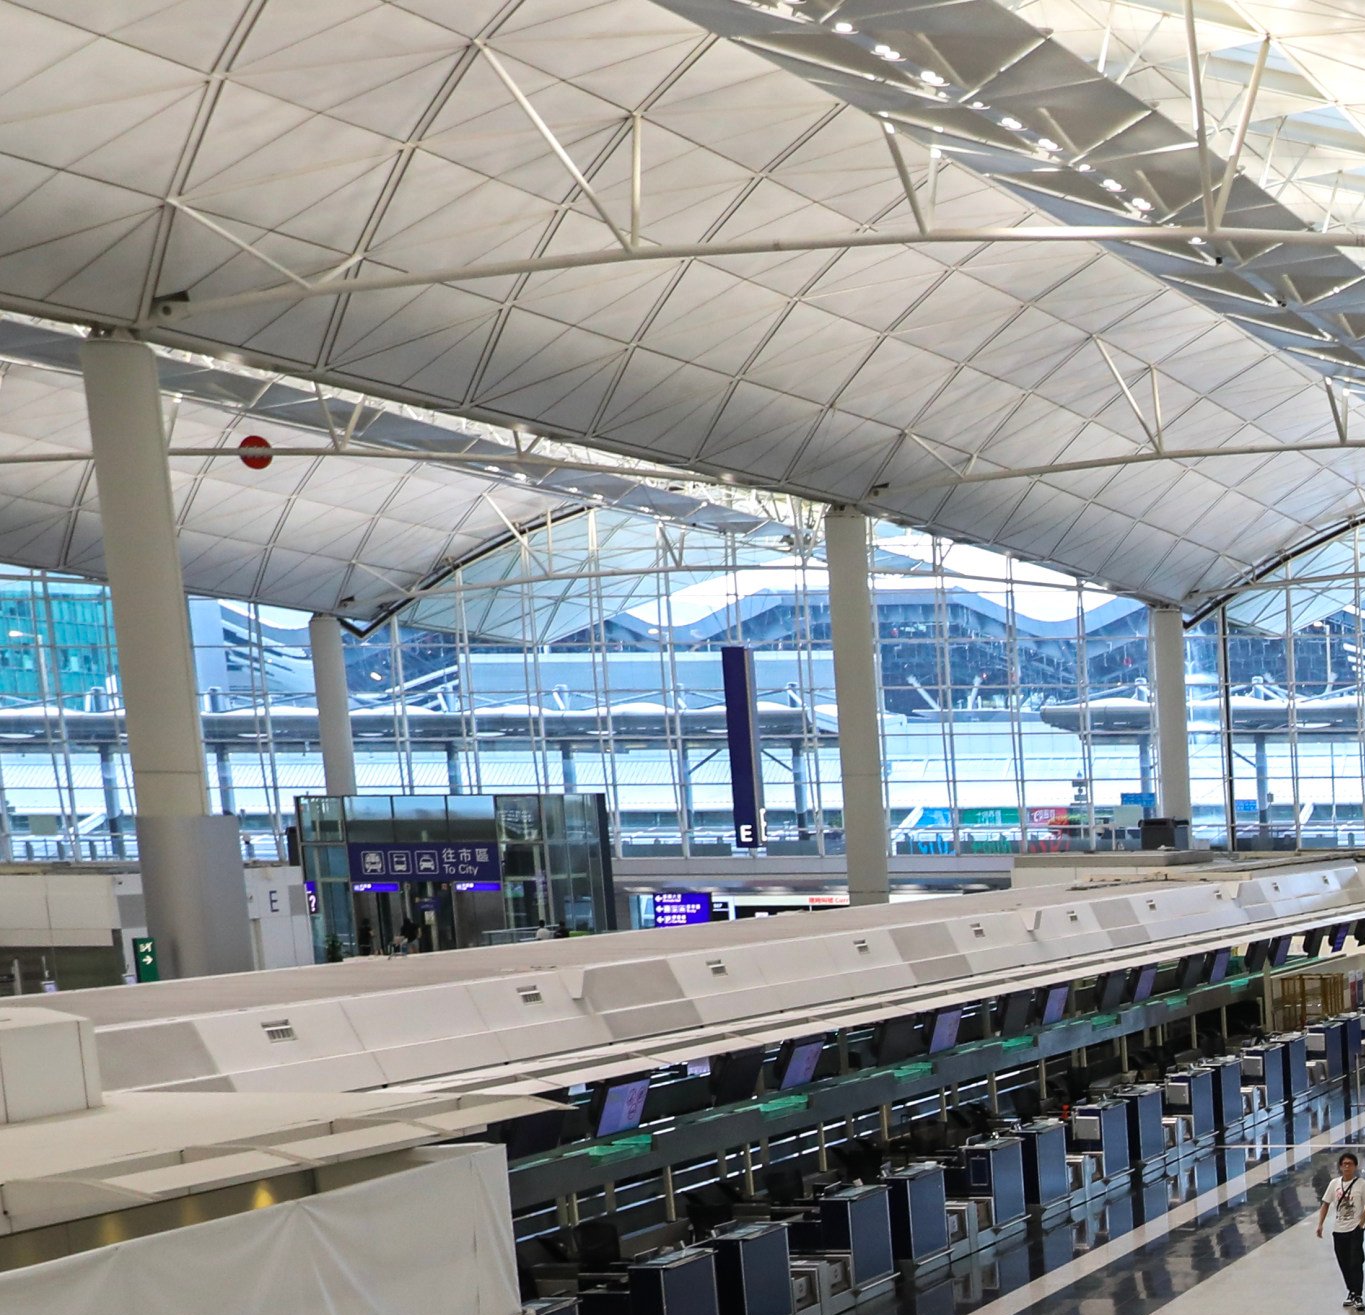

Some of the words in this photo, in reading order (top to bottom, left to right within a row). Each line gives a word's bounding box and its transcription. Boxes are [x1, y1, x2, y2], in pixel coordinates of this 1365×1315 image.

[740, 824, 753, 842] E
[442, 848, 489, 863] 往市區
[442, 864, 456, 874] To
[458, 864, 479, 876] City
[269, 890, 279, 912] E
